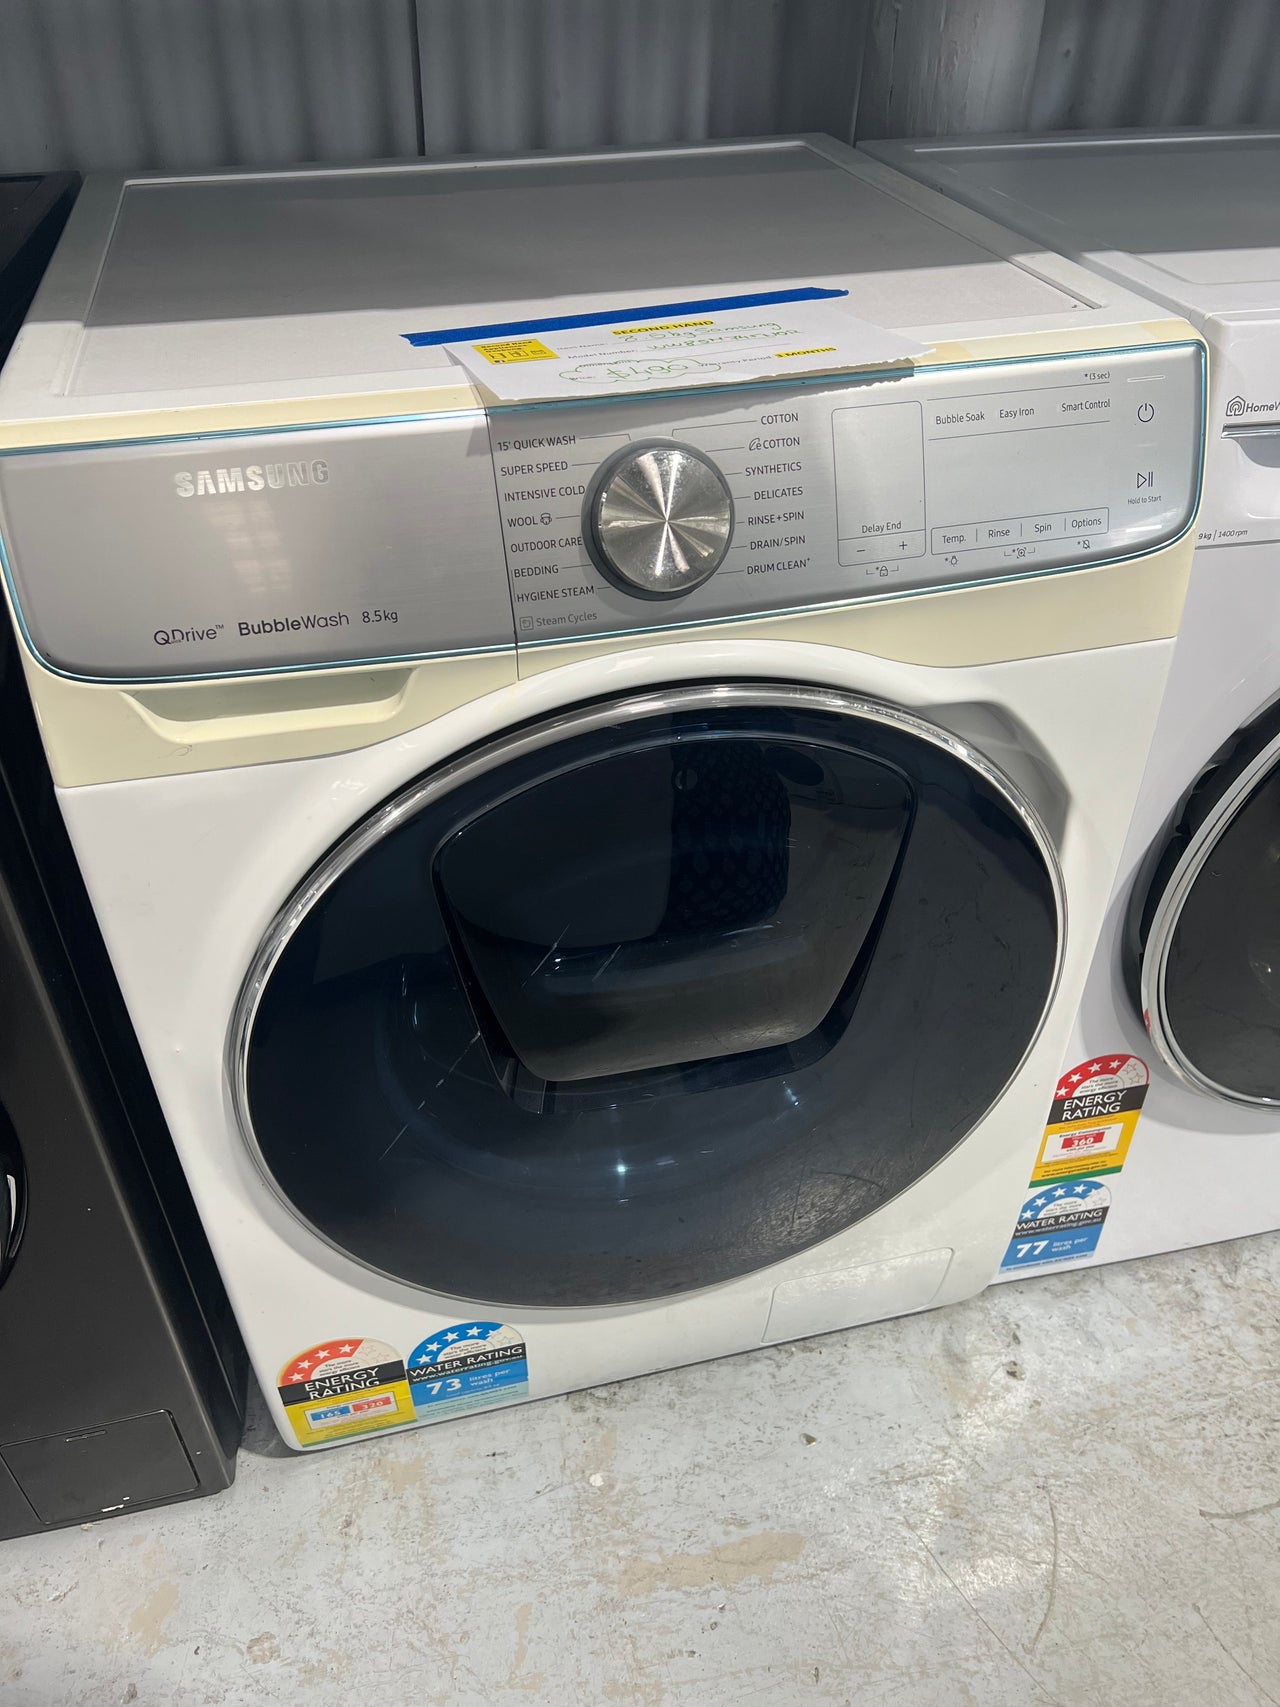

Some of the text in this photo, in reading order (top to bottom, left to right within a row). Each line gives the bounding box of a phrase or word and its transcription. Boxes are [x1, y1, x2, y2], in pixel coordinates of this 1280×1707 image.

[612, 320, 714, 335] SECOND HAND
[785, 347, 837, 357] MONTHS
[1062, 398, 1111, 412] Smart Control
[761, 412, 799, 425] COTTON
[936, 410, 985, 425] Bubble Soak
[999, 406, 1035, 420] Easy Iron
[514, 437, 544, 450] QUICK
[546, 435, 576, 447] WASH
[763, 437, 800, 450] COTTON
[501, 461, 568, 476] SUPER SPEED
[745, 462, 802, 476] SYNTHETICS
[174, 459, 329, 497] SAMSUNG
[504, 485, 585, 502] INTENSIVE COLD
[754, 486, 803, 500] DELICATES
[1127, 496, 1141, 506] Hold
[1148, 495, 1162, 503] Start
[507, 517, 538, 528] WOOL
[861, 520, 902, 534] Delay End
[1034, 522, 1052, 534] Spin
[1071, 517, 1102, 530] Options
[942, 533, 967, 545] Temp.
[988, 526, 1010, 538] Rinse
[510, 537, 583, 553] OUTDOOR CARE
[750, 535, 806, 550] DRAIN/SPIN
[514, 565, 559, 578] BEDDING
[747, 563, 775, 575] DRUM
[517, 586, 594, 602] HYGIENE STEAM
[238, 612, 350, 636] BubbleWash
[362, 610, 399, 624] 8.5kg
[536, 611, 598, 627] Steam Cycles
[1063, 1090, 1128, 1110] ENERGY
[1062, 1102, 1122, 1120] RATING
[1072, 1138, 1094, 1148] 360
[1016, 1208, 1103, 1230] WATER RATING
[1016, 1240, 1050, 1258] 77
[1074, 1236, 1088, 1245] per
[410, 1346, 523, 1376] WATER RATING
[304, 1367, 379, 1392] ENERGY
[426, 1378, 462, 1395] 73
[494, 1368, 510, 1377] per
[470, 1378, 494, 1386] wash
[309, 1378, 380, 1400] RATING
